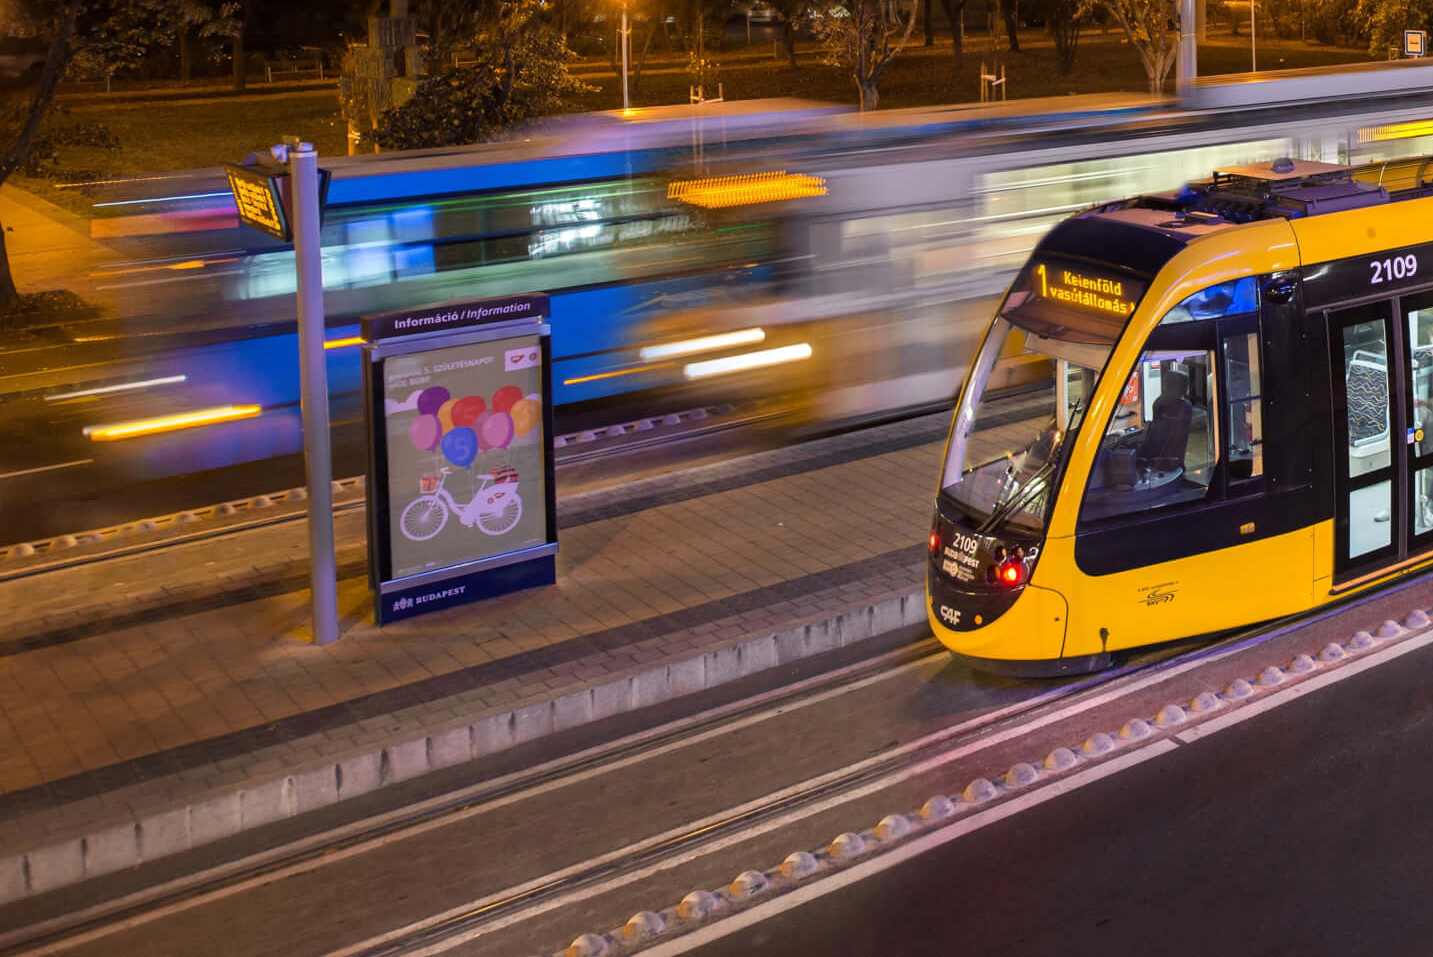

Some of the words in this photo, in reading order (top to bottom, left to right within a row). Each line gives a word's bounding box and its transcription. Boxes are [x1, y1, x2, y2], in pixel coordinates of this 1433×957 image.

[1037, 263, 1048, 298] 1
[1370, 254, 1418, 285] 2109
[394, 311, 459, 329] Információ
[467, 302, 531, 320] Information
[456, 437, 471, 460] 5
[953, 532, 978, 554] 2109
[415, 586, 466, 605] BUDAPEST
[940, 605, 961, 625] CAF
